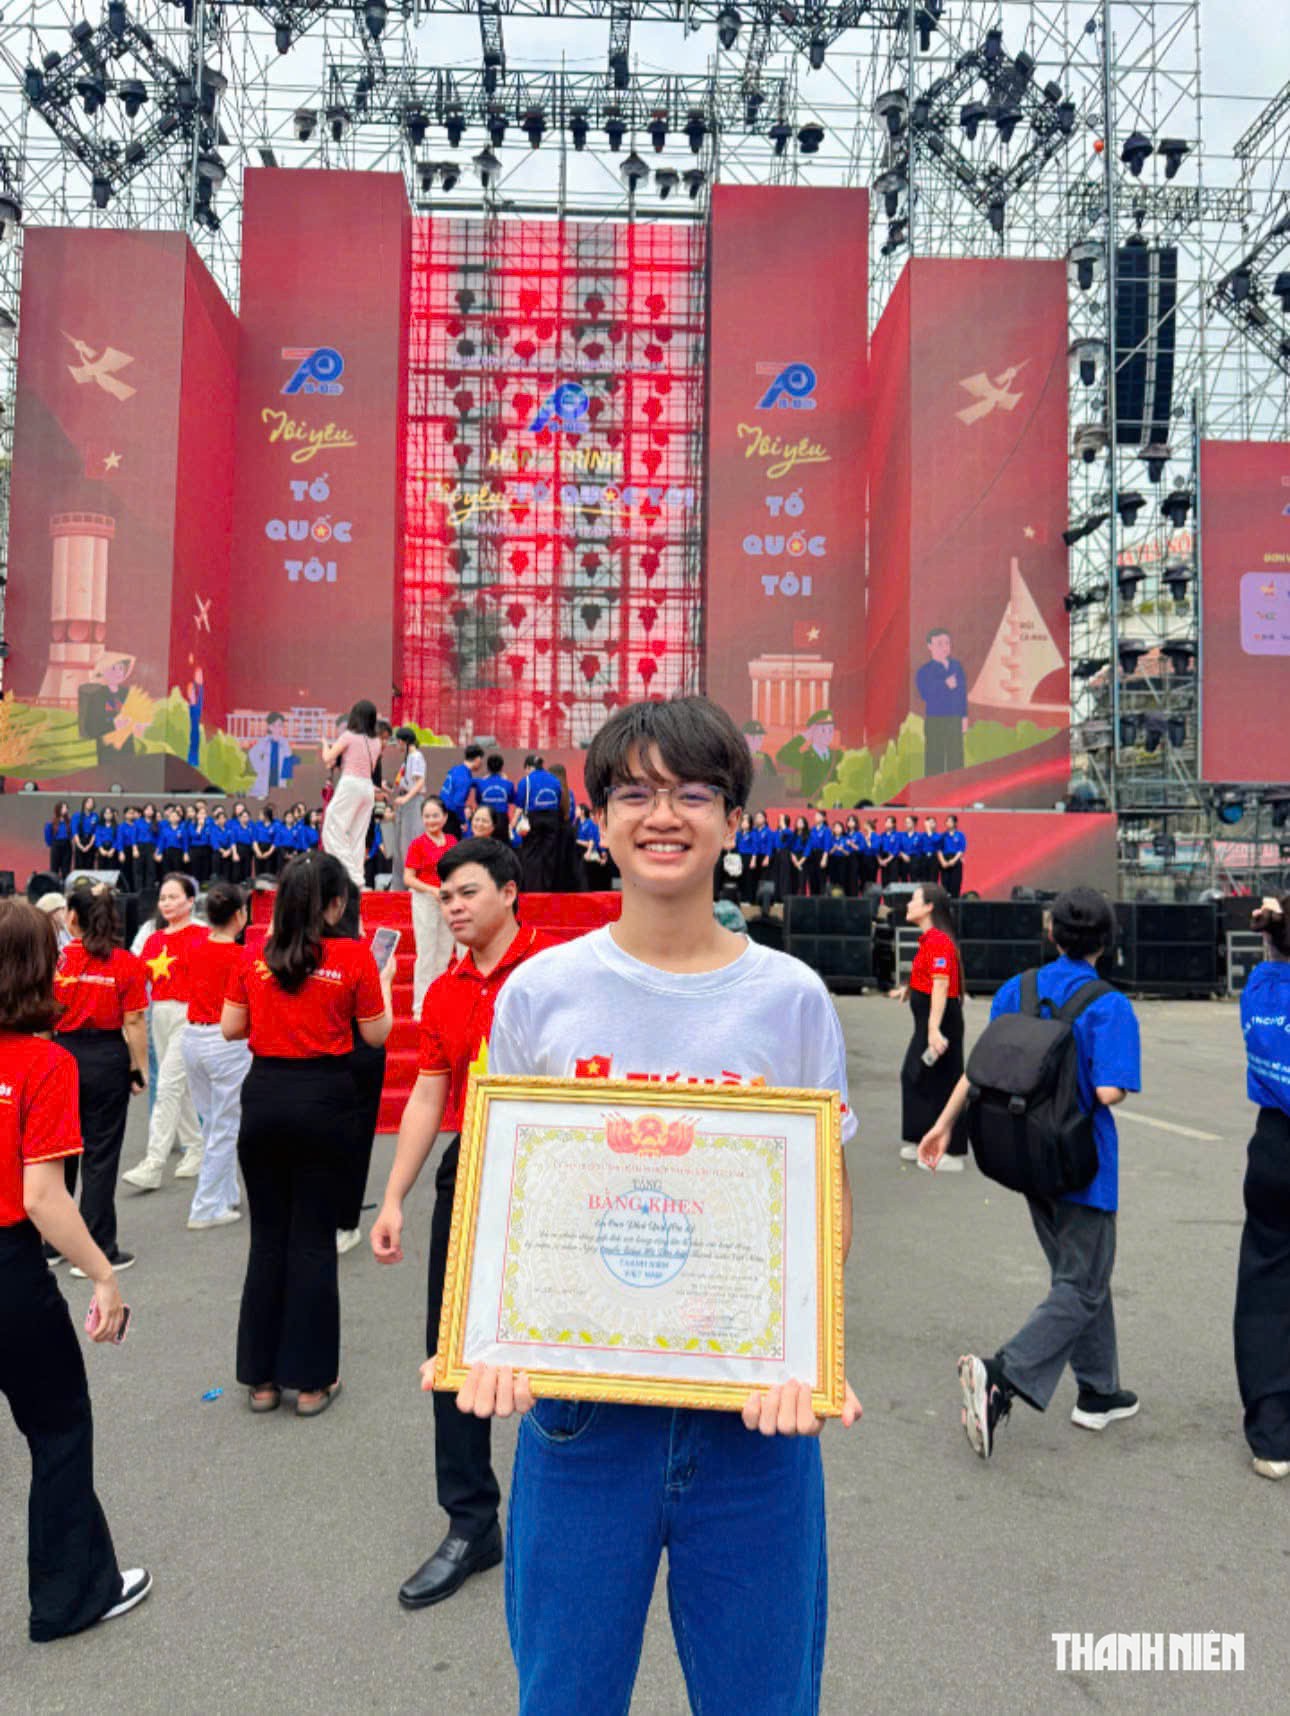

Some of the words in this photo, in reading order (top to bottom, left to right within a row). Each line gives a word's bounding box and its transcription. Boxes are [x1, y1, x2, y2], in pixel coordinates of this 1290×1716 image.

[265, 514, 353, 542] QUỐC
[742, 529, 827, 557] QUỐC
[284, 556, 338, 582] TÔI
[761, 571, 813, 596] TÔI
[648, 1198, 704, 1215] KHEN
